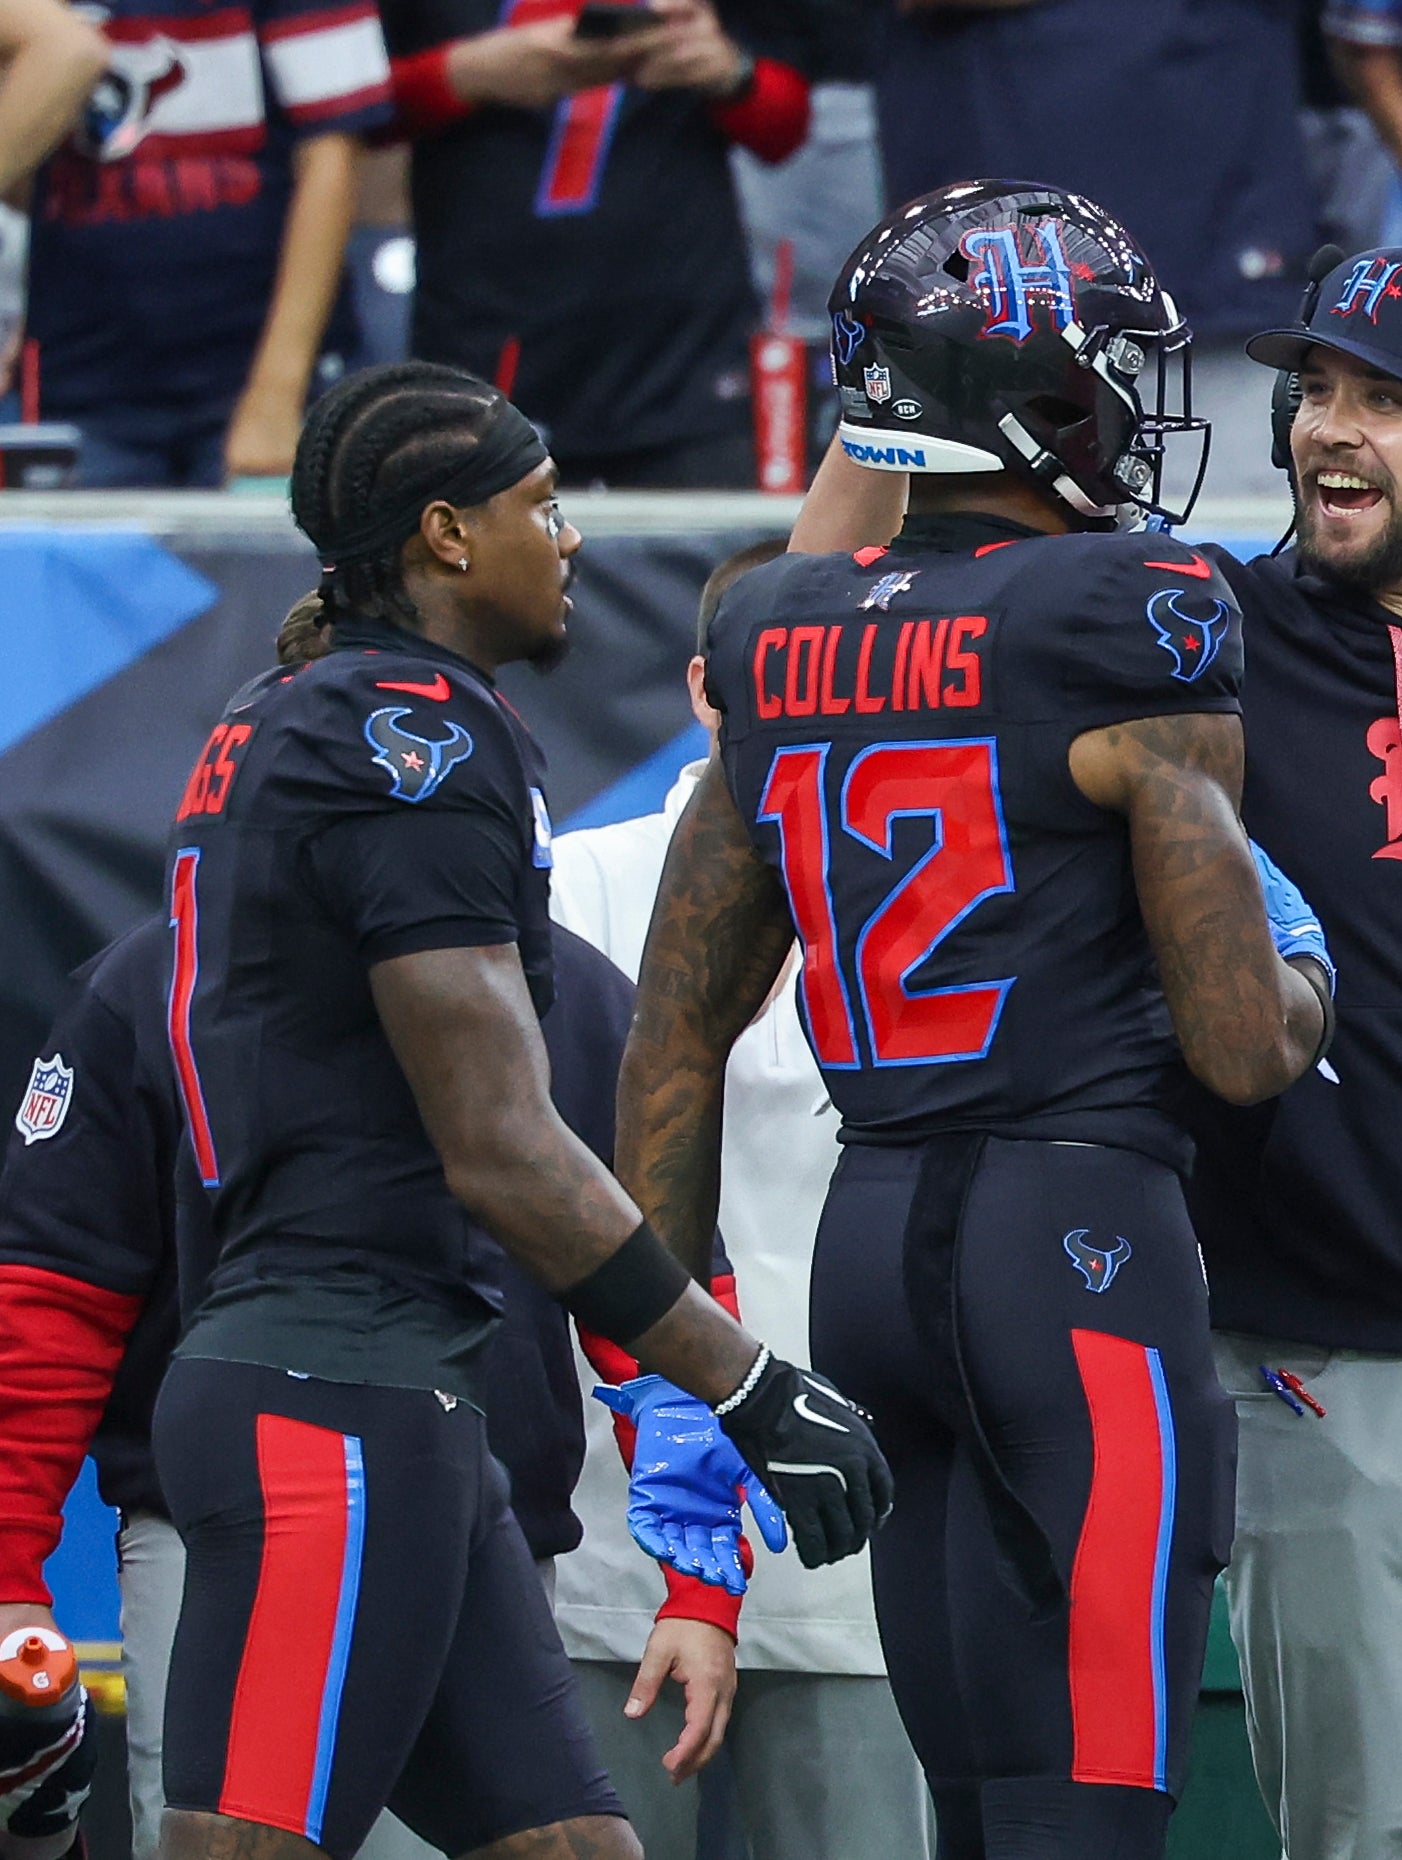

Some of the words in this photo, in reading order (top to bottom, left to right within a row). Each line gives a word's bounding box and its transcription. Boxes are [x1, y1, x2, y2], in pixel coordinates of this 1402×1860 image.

[868, 380, 888, 397] NFL
[753, 615, 989, 720] COLLINS
[175, 722, 254, 822] GS
[756, 736, 1017, 1070] 12
[168, 846, 221, 1189] 1
[24, 1091, 58, 1127] NFL
